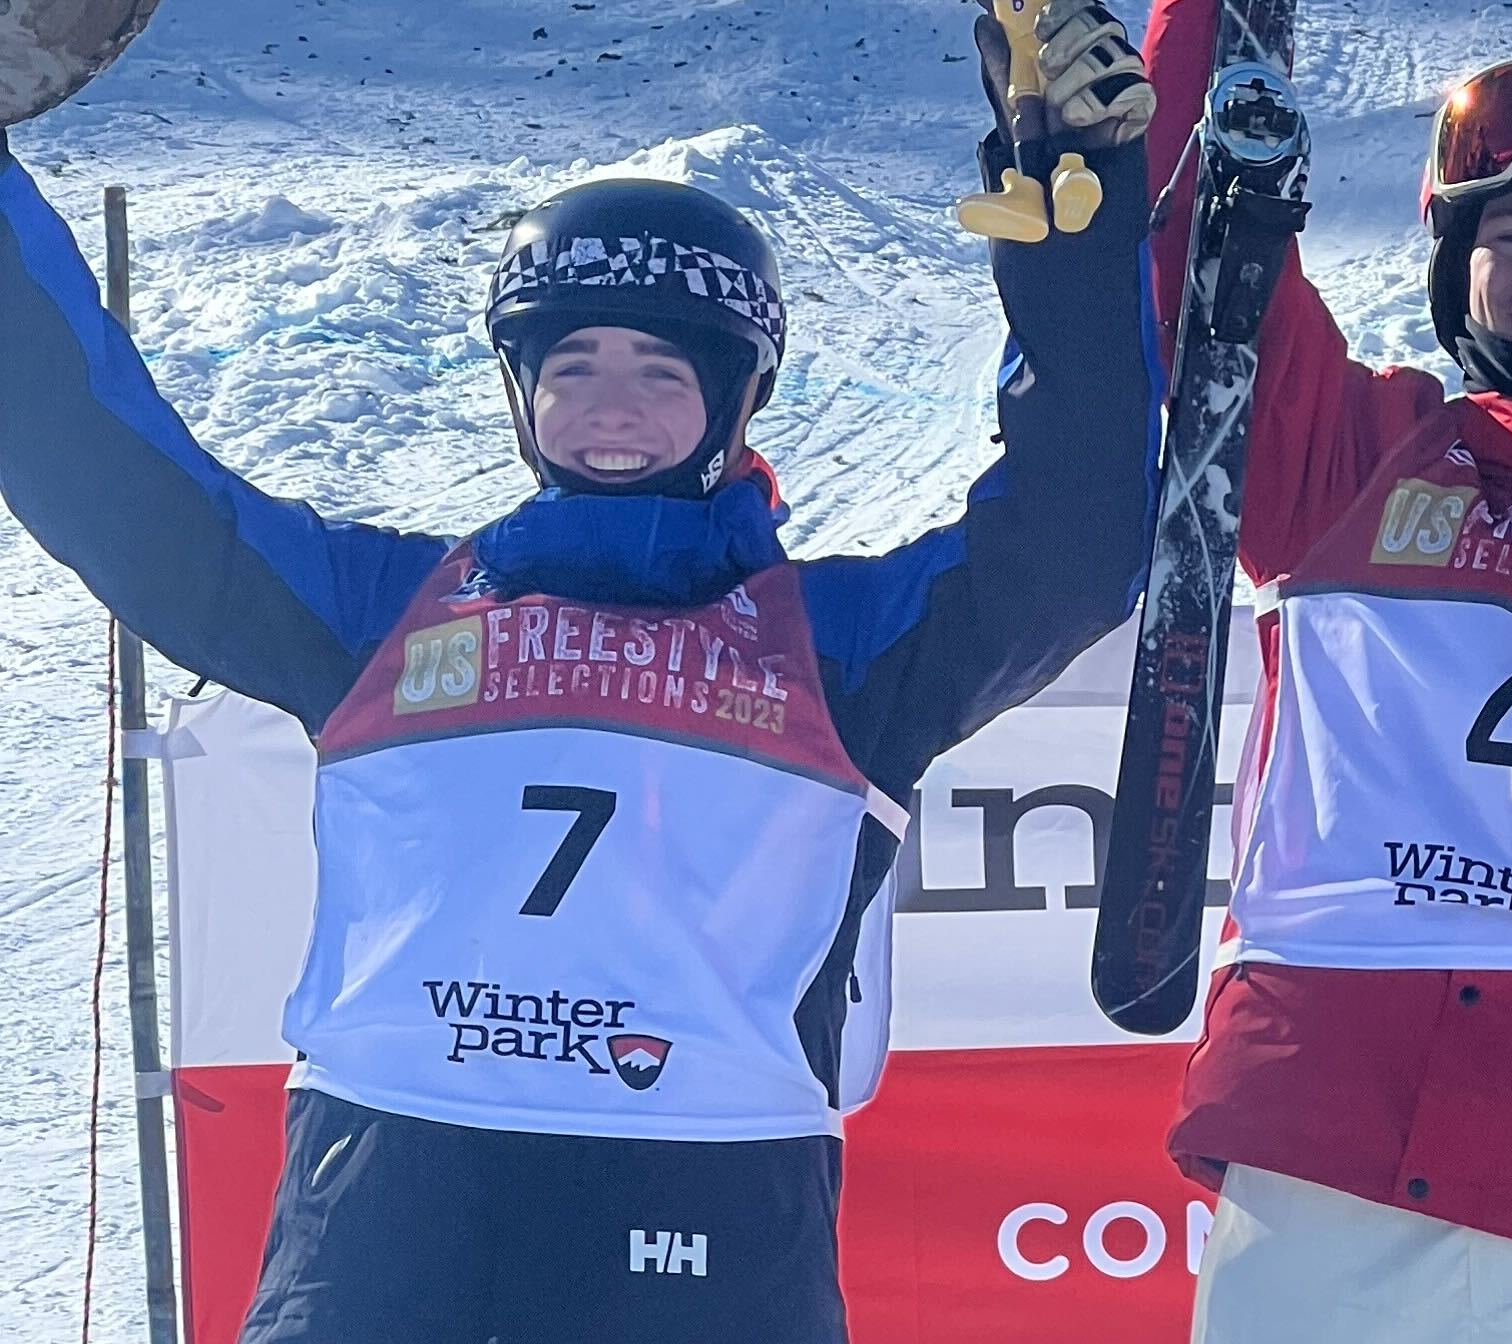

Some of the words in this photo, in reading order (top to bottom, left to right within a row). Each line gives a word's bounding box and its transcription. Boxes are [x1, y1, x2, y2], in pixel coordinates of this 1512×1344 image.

[1382, 489, 1464, 554] US
[402, 630, 478, 702] US
[485, 605, 789, 702] FREESTYLE
[484, 660, 709, 714] SELECTIONS
[715, 688, 786, 735] 2023
[519, 785, 617, 917] 7
[422, 981, 635, 1029] Winter
[447, 1022, 610, 1074] park
[630, 1230, 708, 1277] HH
